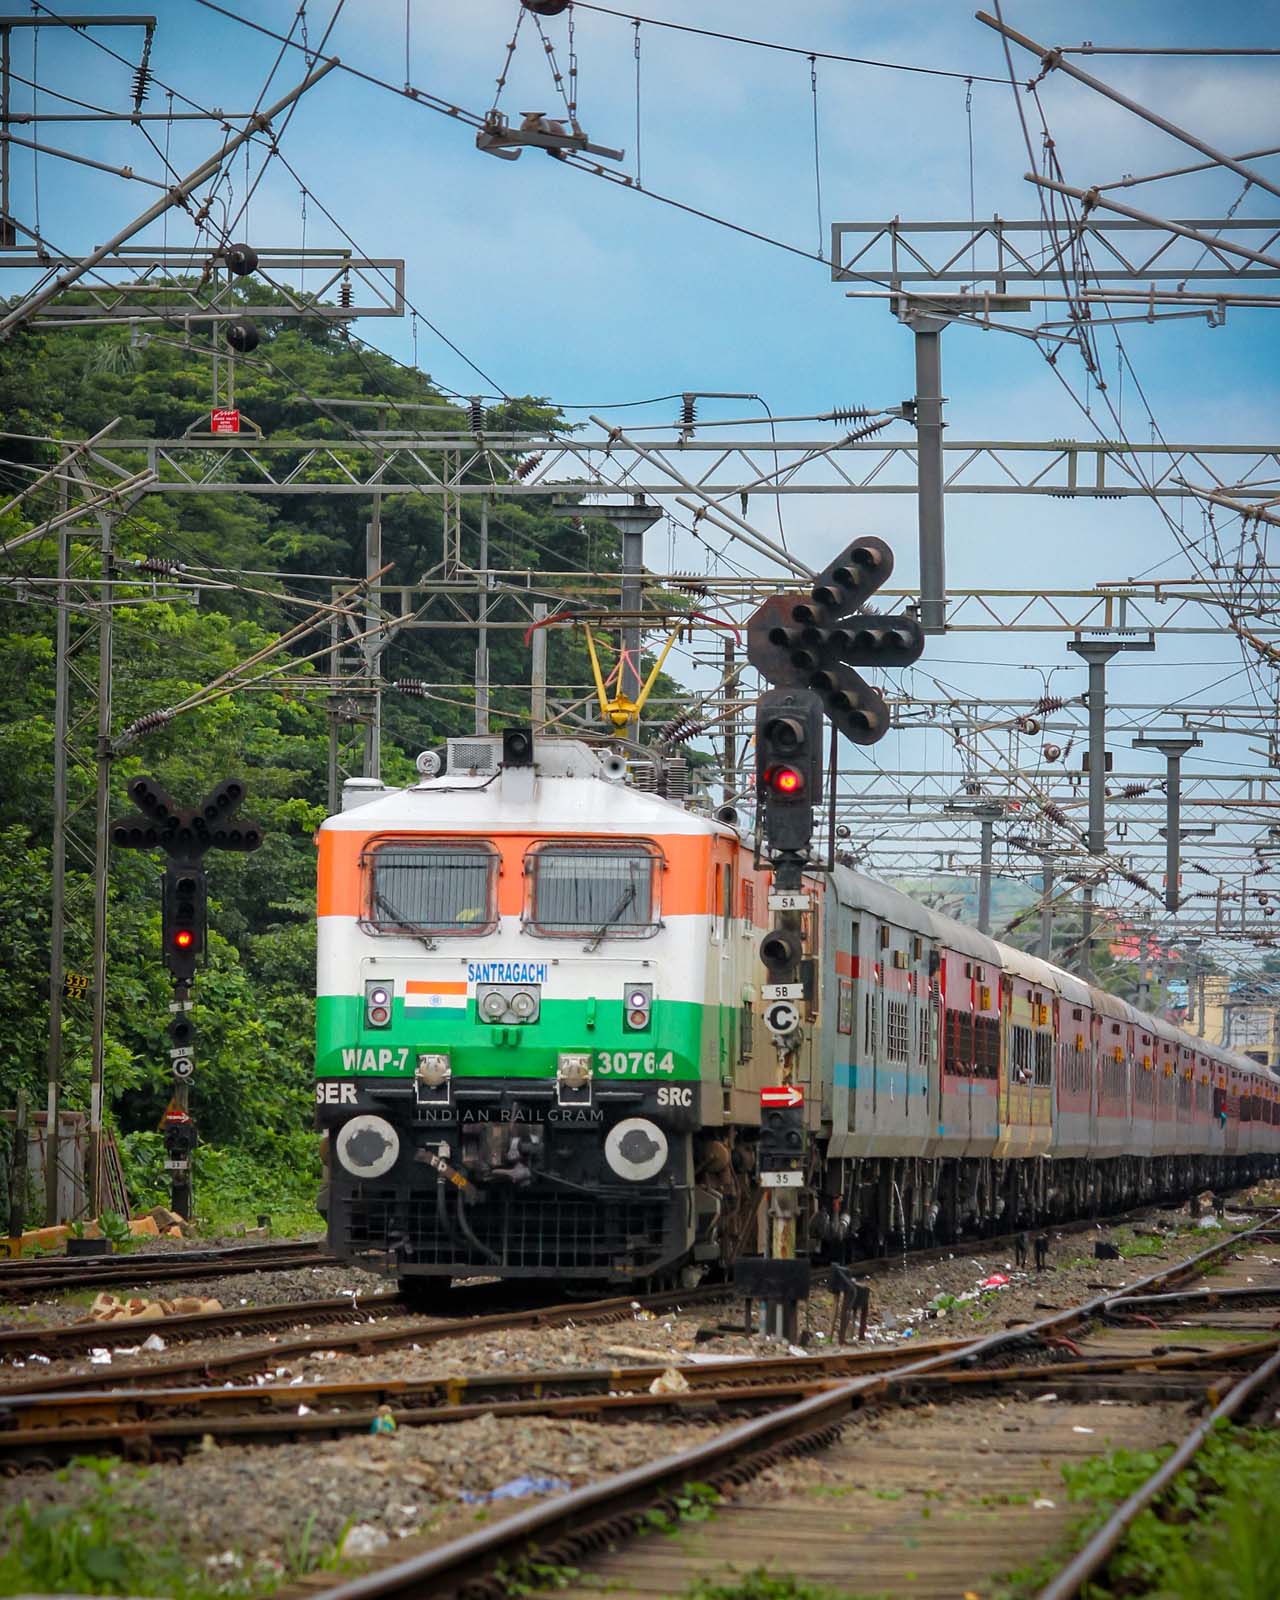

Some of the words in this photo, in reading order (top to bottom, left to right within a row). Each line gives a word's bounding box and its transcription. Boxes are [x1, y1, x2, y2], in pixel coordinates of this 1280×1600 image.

[781, 897, 796, 908] 5A
[66, 974, 87, 987] 533
[468, 963, 548, 982] SANTRAGACHI
[66, 987, 81, 998] 22
[775, 986, 788, 997] 5B
[769, 1005, 792, 1030] C
[175, 1060, 189, 1075] C
[341, 1048, 409, 1071] WAP-7
[598, 1052, 674, 1074] 30764
[316, 1082, 358, 1104] SER
[657, 1087, 692, 1107] SRC
[775, 1173, 789, 1184] 35
